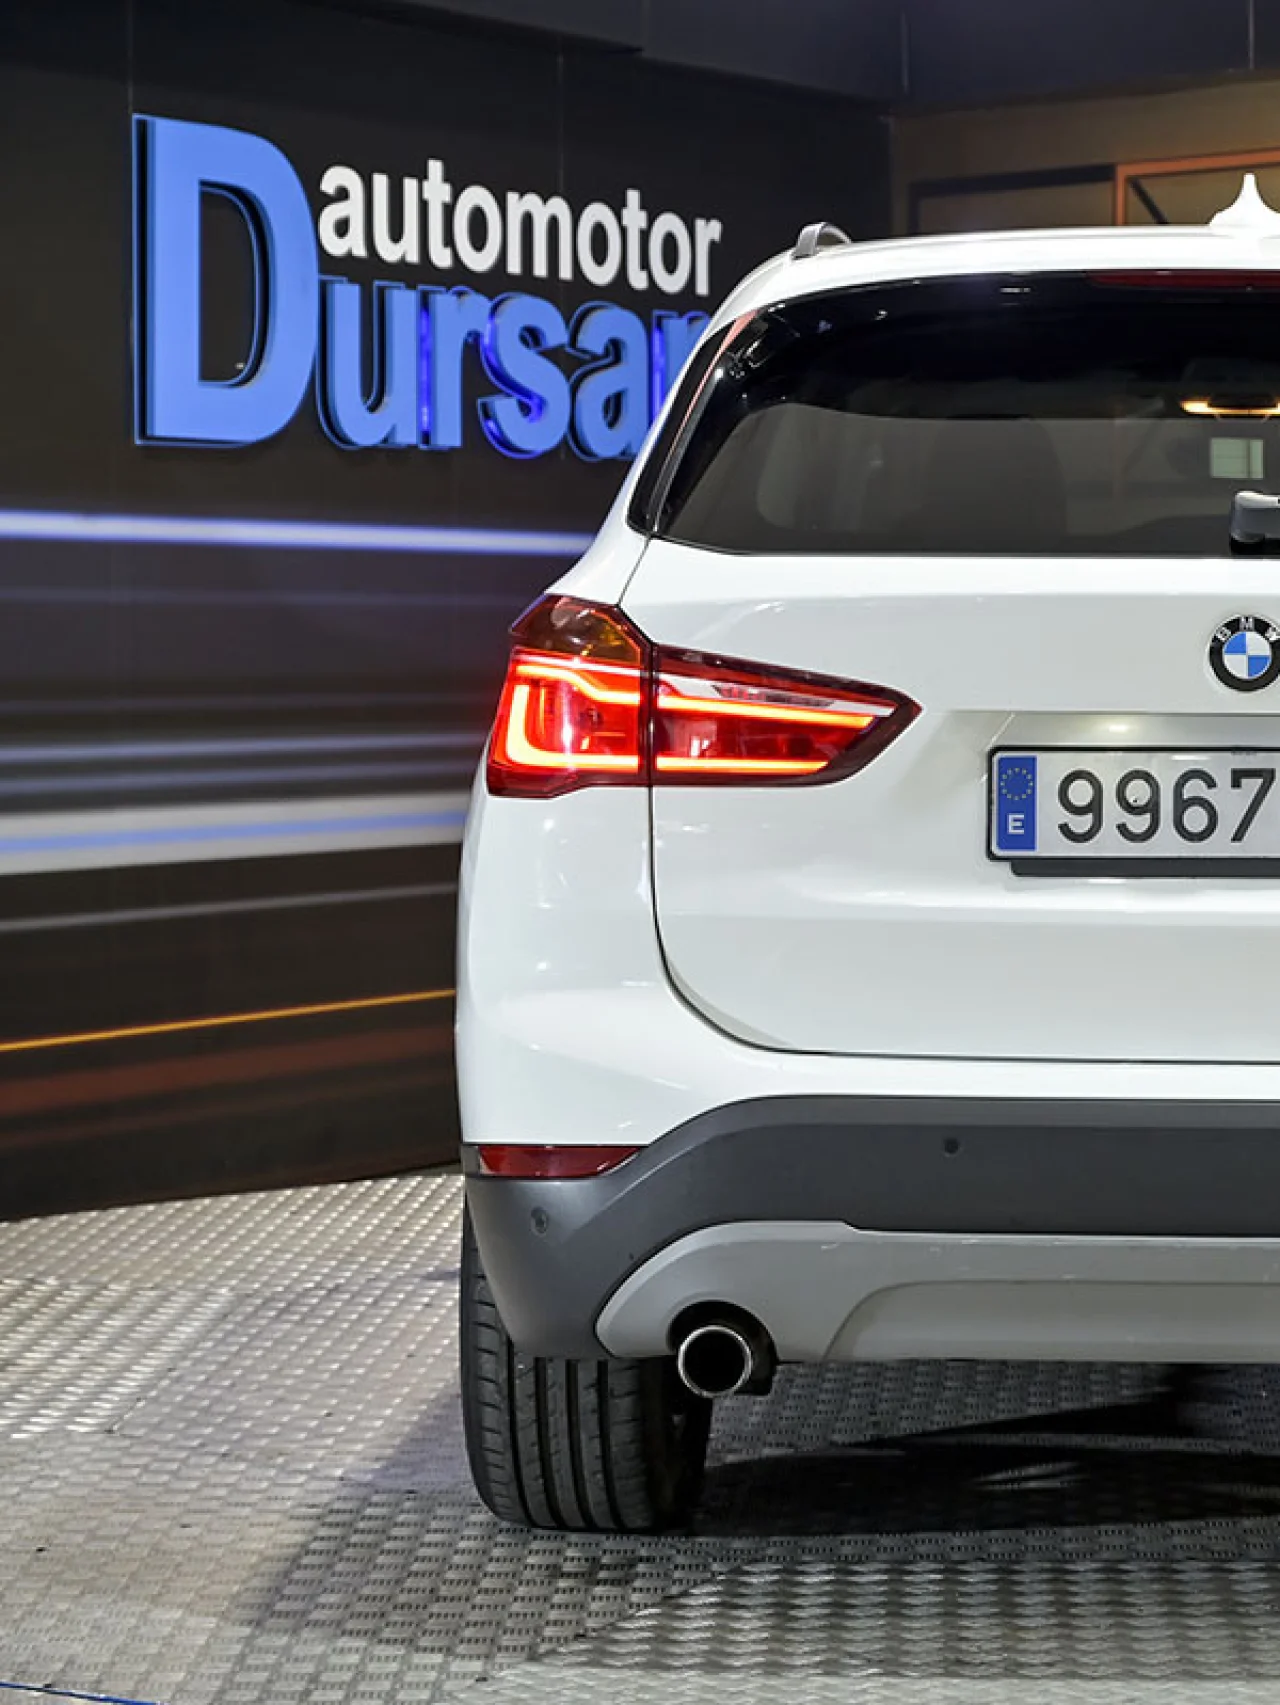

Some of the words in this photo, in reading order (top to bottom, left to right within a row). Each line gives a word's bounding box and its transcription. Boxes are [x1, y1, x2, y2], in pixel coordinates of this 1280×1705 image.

[318, 159, 722, 296] automotor
[1007, 813, 1025, 835] E
[1057, 769, 1277, 844] 9967
